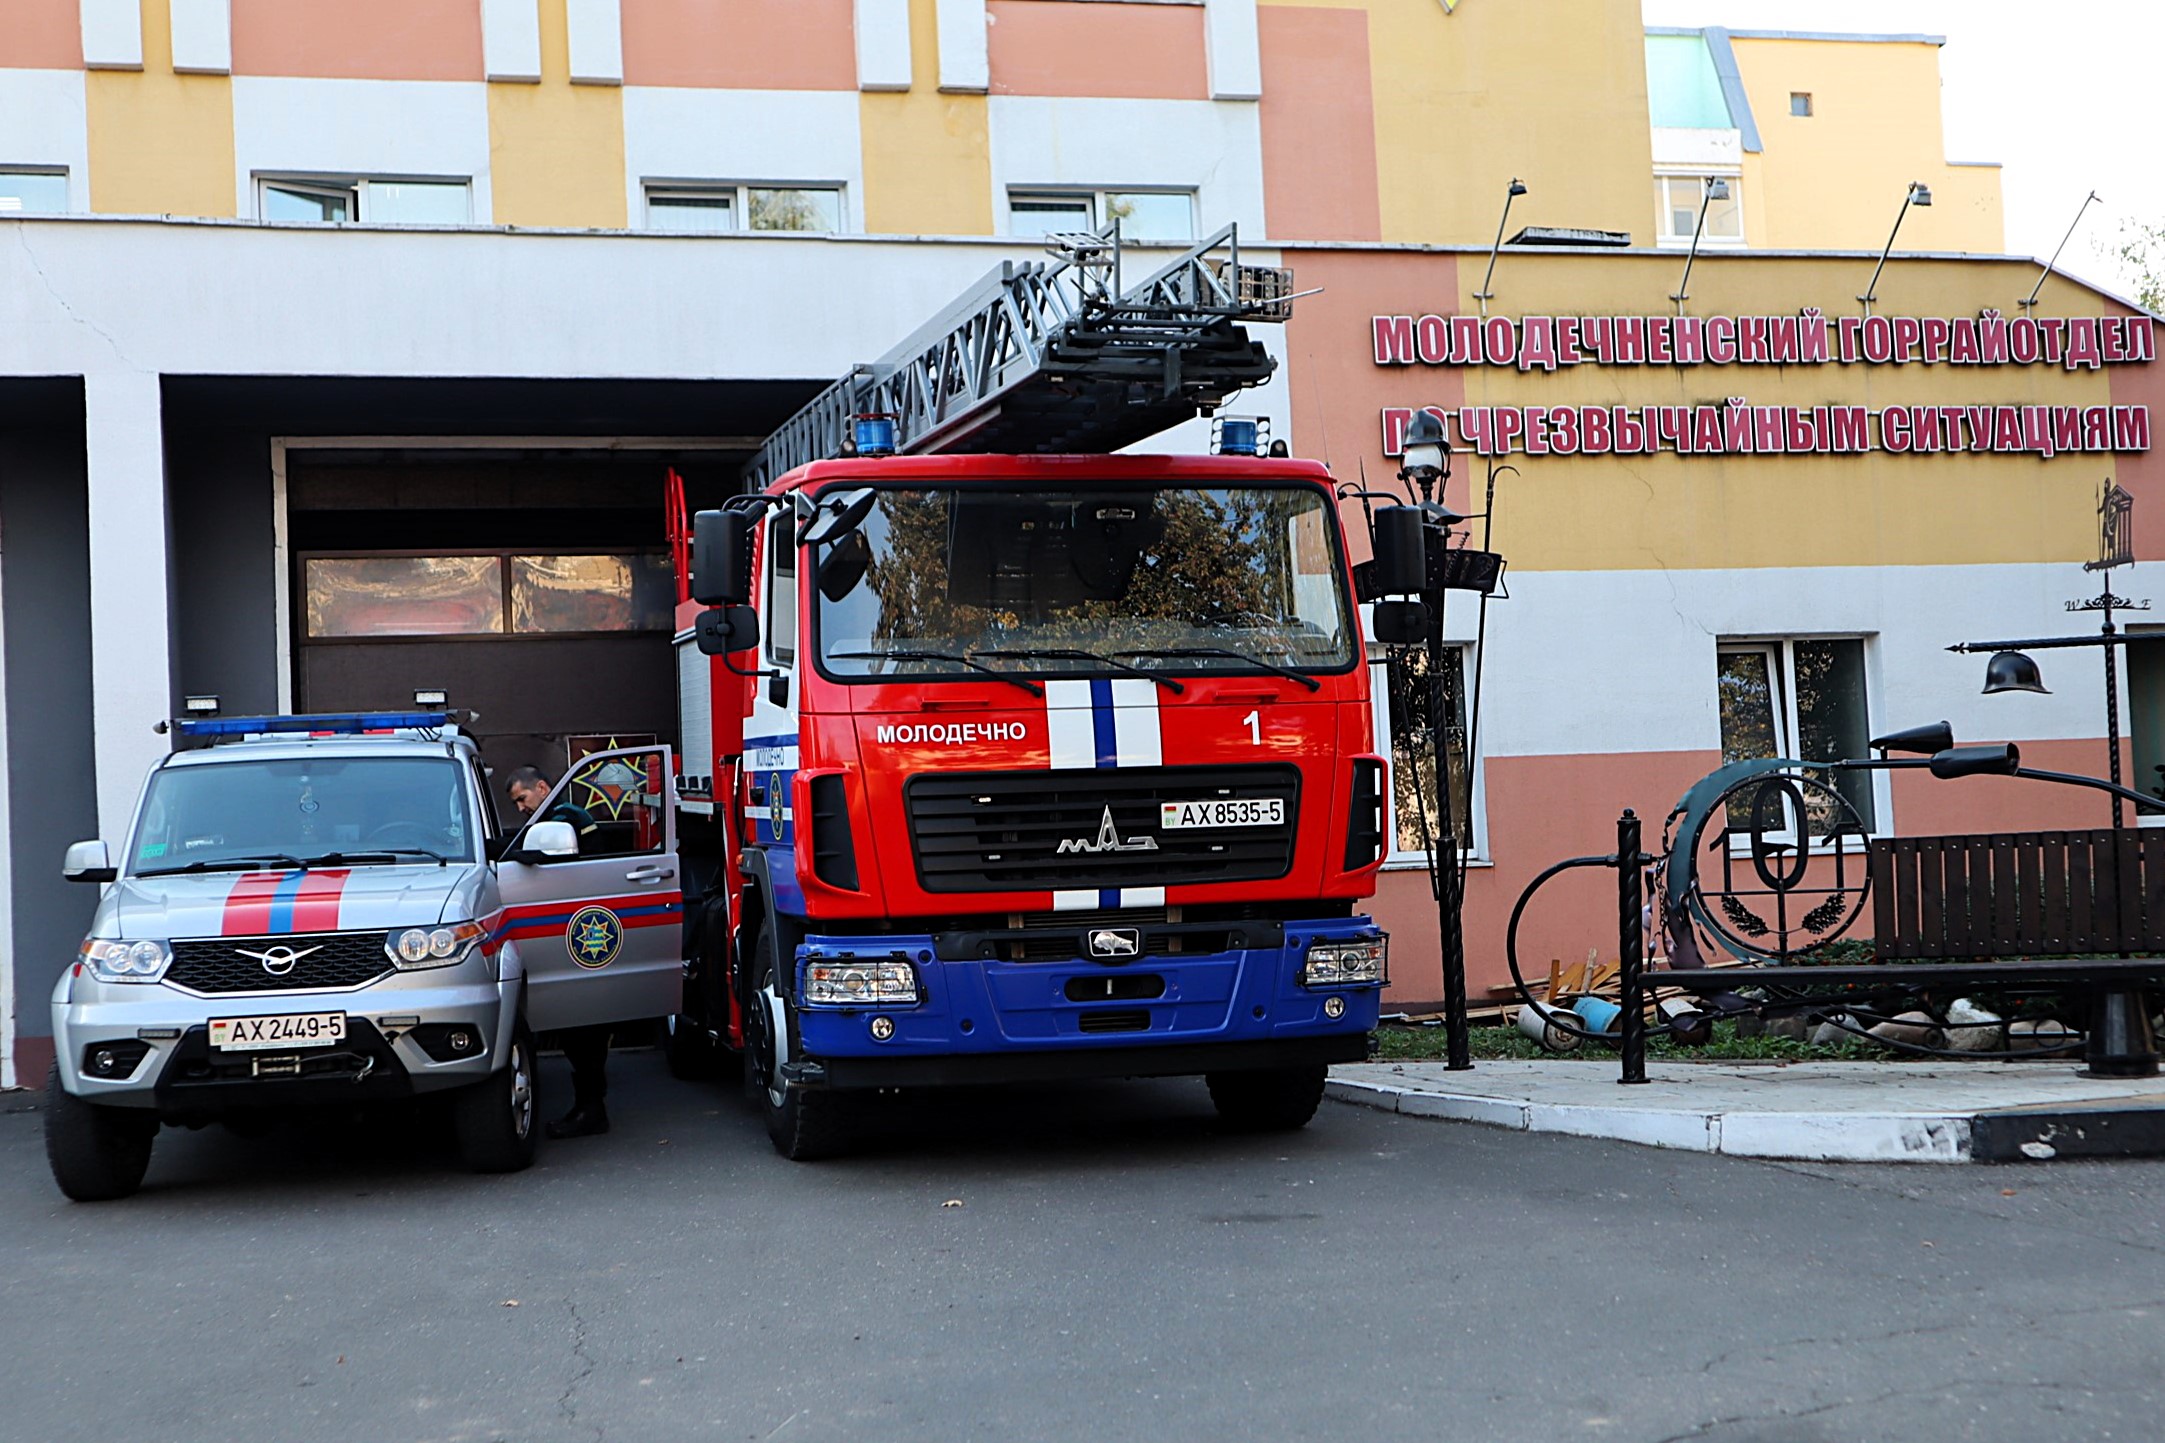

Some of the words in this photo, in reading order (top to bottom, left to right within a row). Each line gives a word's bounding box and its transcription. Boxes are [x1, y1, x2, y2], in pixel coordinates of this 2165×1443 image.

[1372, 307, 1829, 371] МОЛОДЕЧНЕНСКИЙ
[1839, 309, 2156, 370] ГОРРАЙОТДЕЛ
[1459, 397, 1870, 454] ЧРЕЗВЫЧАЙНЫМ
[1881, 405, 2151, 458] СИТУАЦИЯМ
[877, 721, 1026, 745] МОЛОДЕЧНО
[1243, 710, 1261, 745] 1
[1215, 801, 1281, 824] 8535-5
[1709, 778, 1845, 894] 101
[269, 1016, 342, 1041] 2449-5
